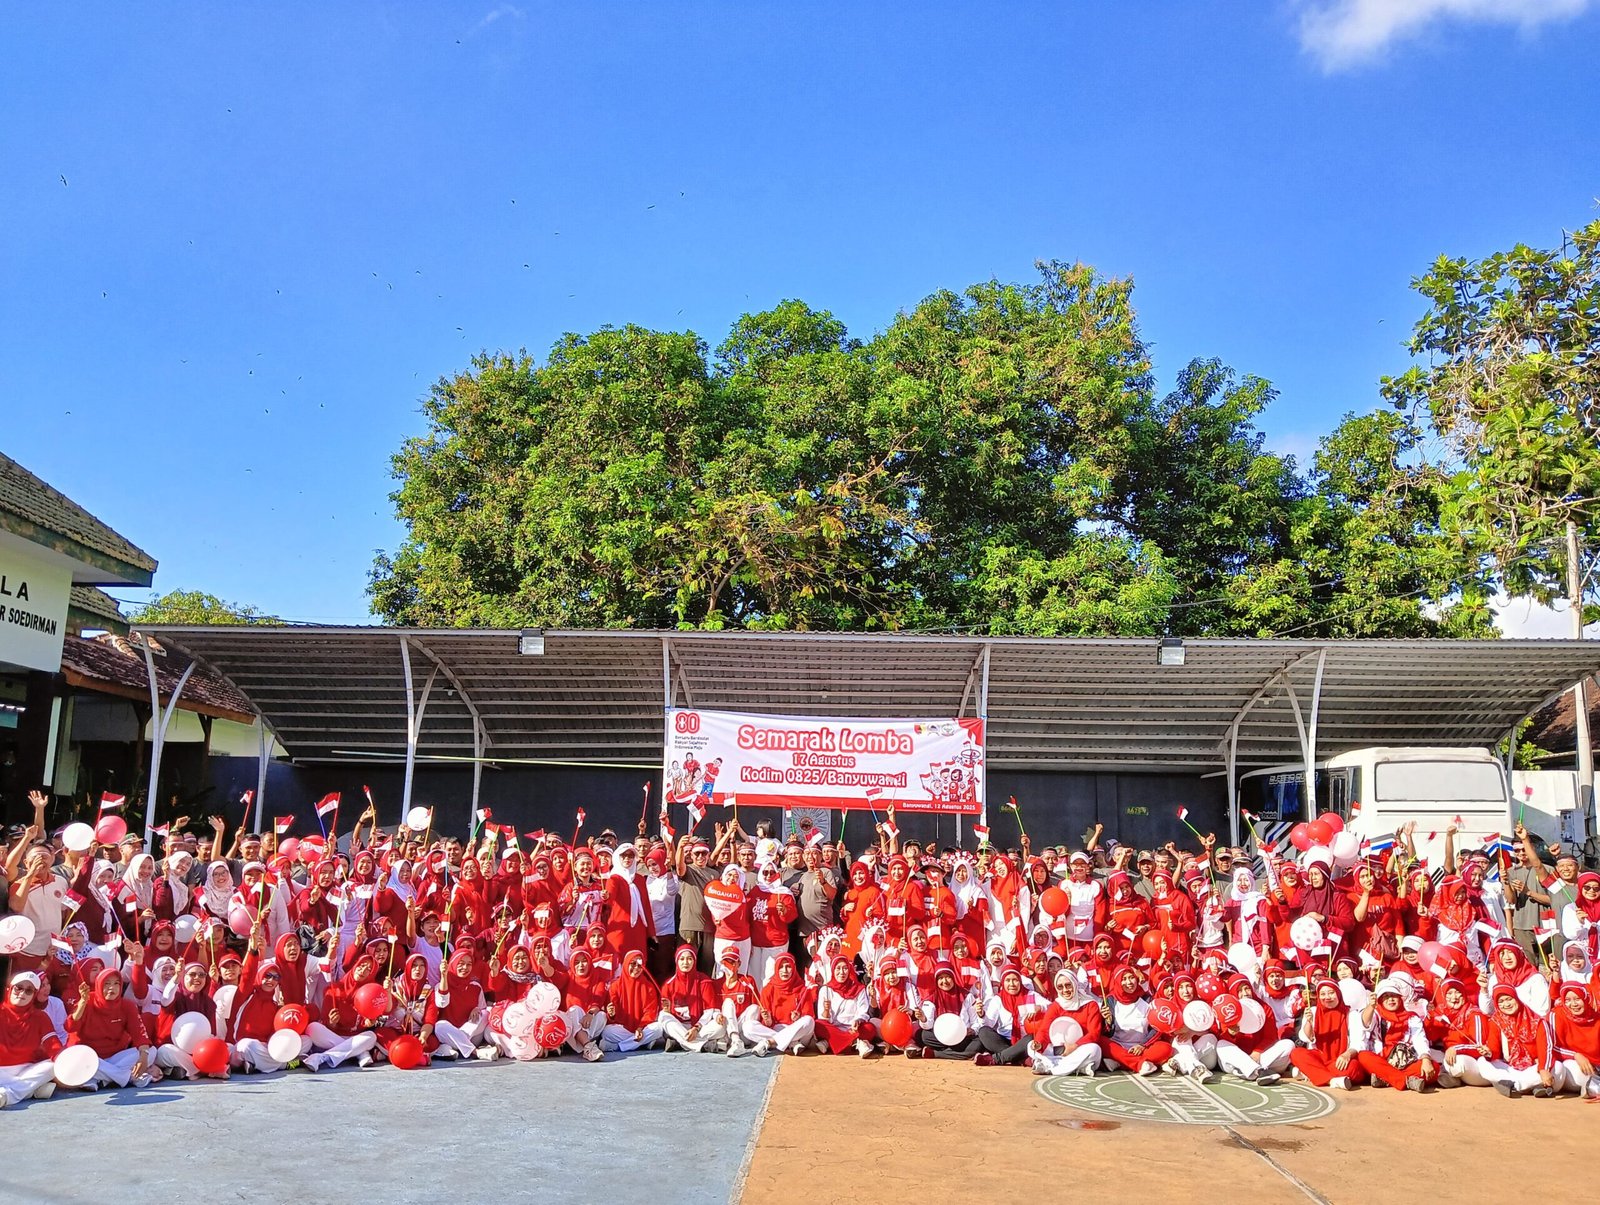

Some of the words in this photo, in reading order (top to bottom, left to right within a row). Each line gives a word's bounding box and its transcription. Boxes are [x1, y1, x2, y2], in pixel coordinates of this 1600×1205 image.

[8, 608, 57, 636] SOEDIRMAN
[675, 711, 700, 734] 80
[737, 724, 835, 752] Semarak
[839, 728, 913, 755] Lomba
[793, 753, 807, 766] 17
[808, 753, 856, 768] Agustus
[740, 766, 783, 783] Kodim
